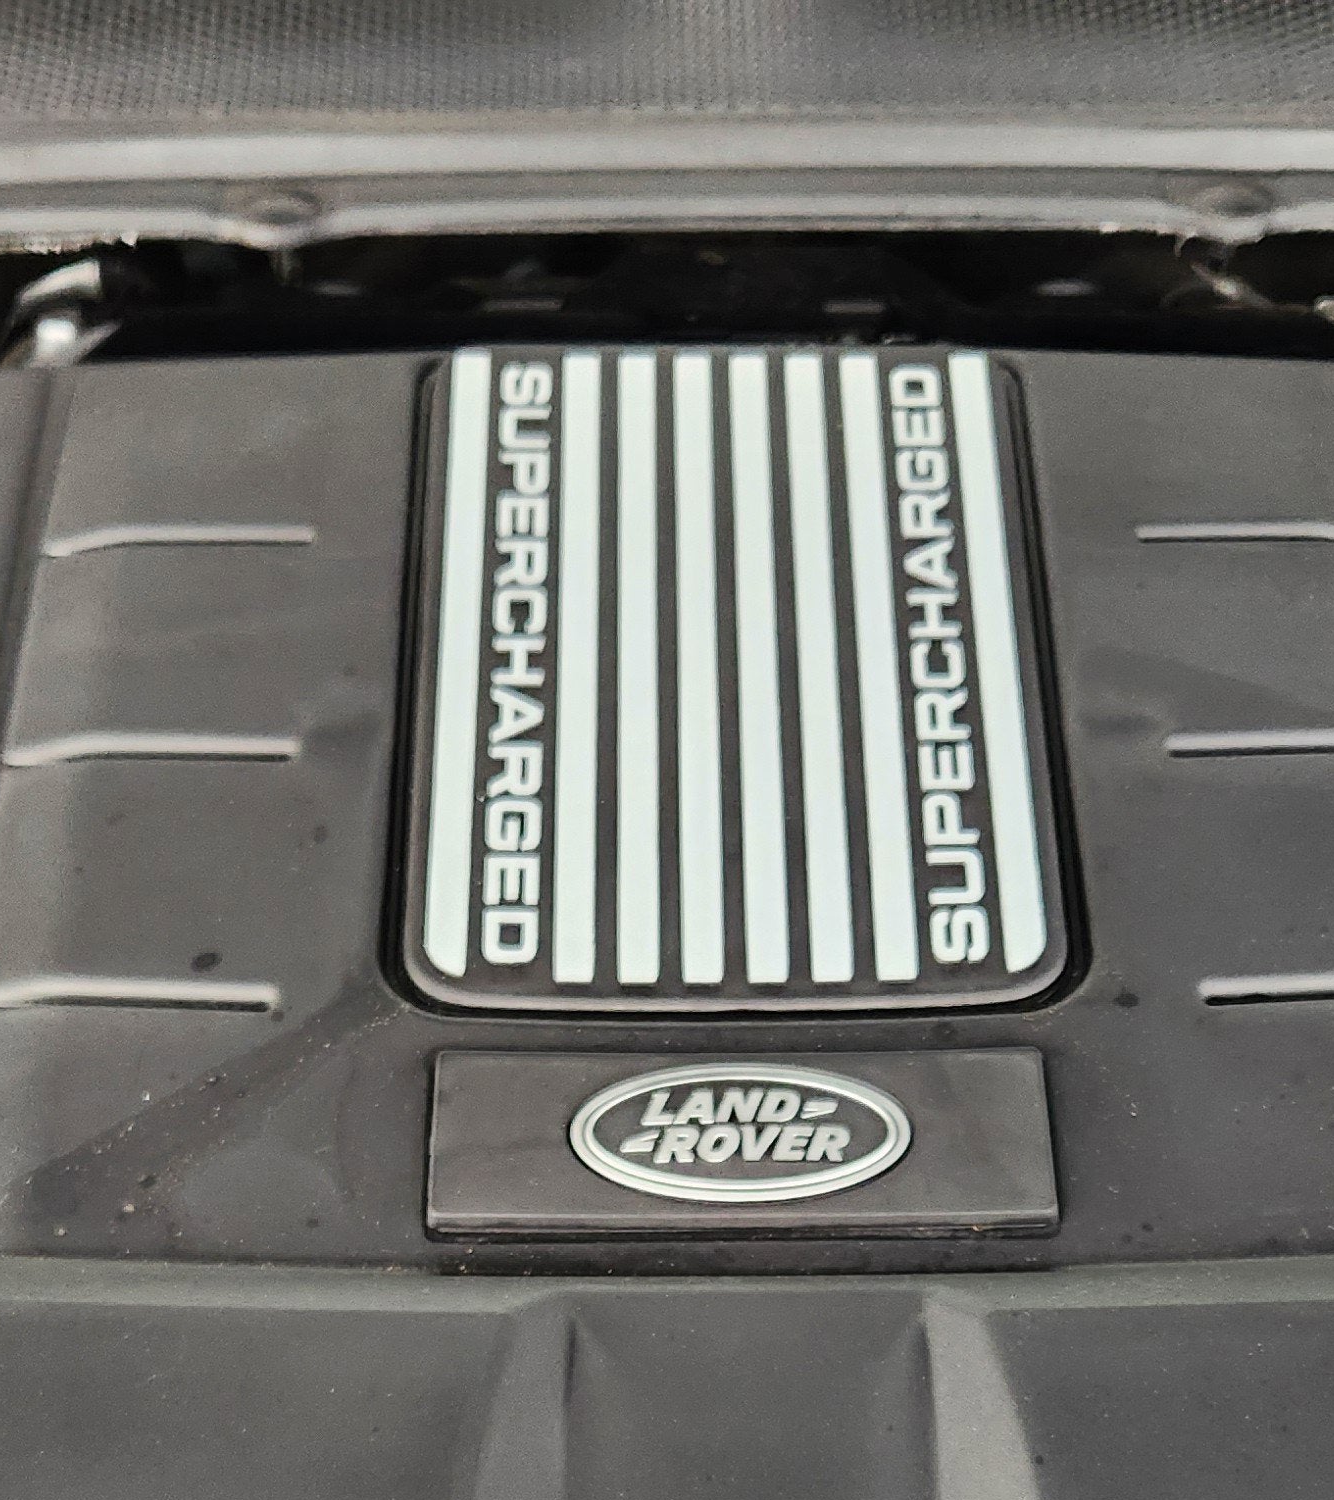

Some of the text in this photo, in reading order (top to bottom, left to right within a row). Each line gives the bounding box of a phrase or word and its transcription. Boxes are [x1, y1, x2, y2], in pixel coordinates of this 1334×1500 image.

[481, 361, 553, 965] SUPERCHARGED
[888, 363, 990, 965] SUPERCHARGED
[641, 1087, 801, 1126] LAND
[653, 1122, 851, 1163] ROVER
